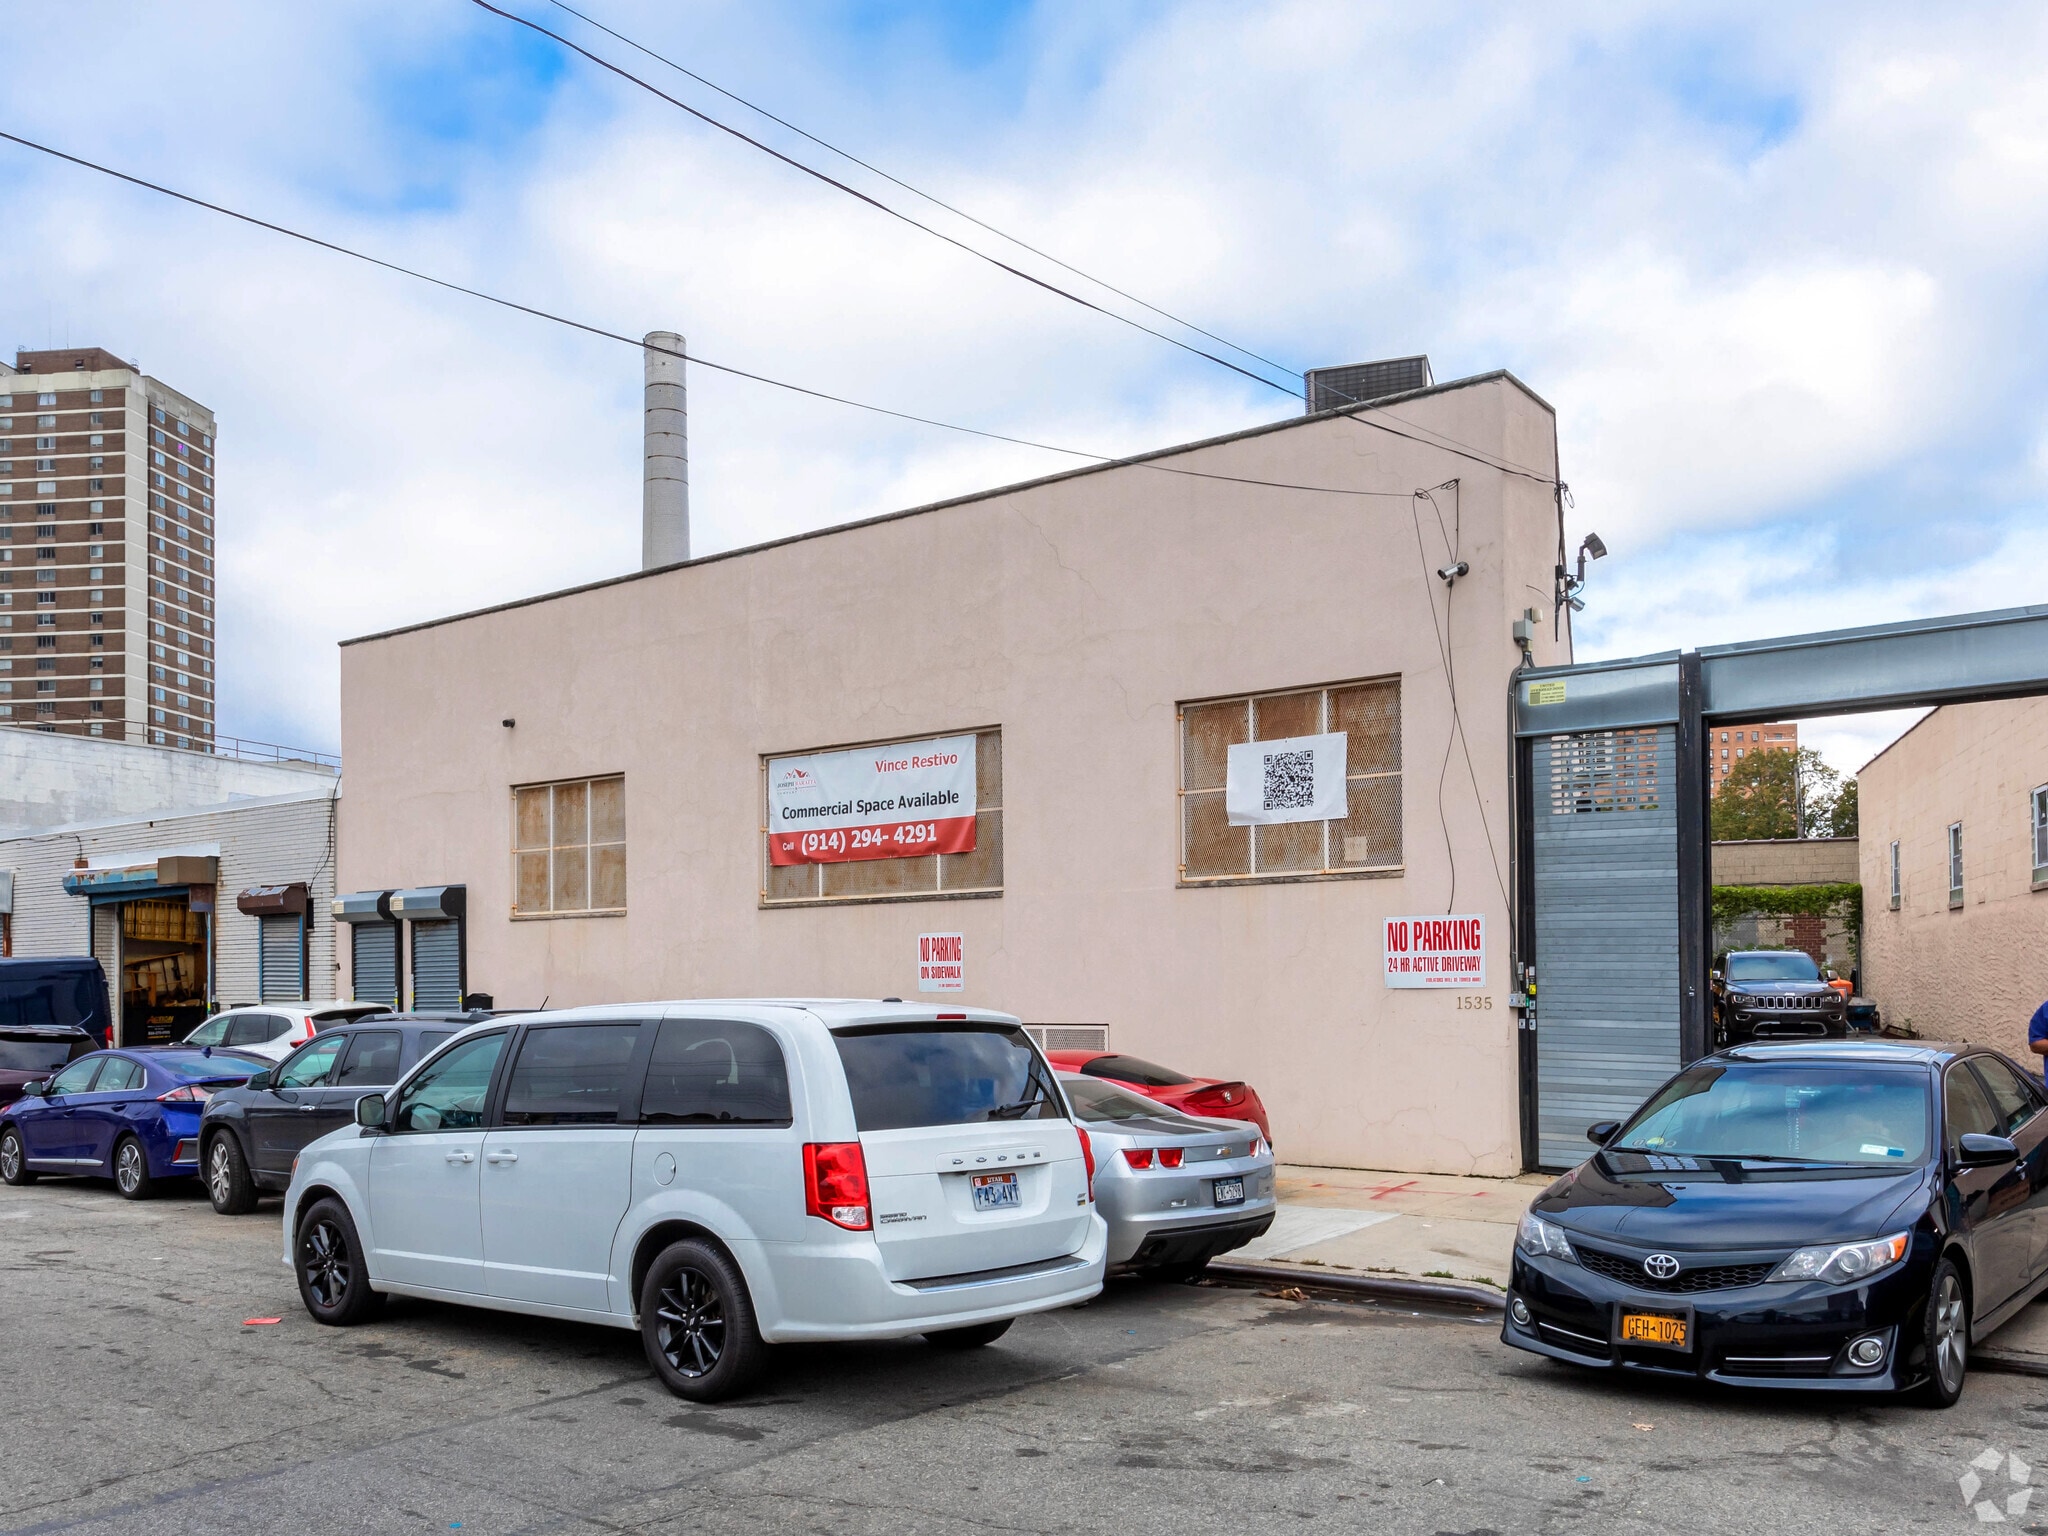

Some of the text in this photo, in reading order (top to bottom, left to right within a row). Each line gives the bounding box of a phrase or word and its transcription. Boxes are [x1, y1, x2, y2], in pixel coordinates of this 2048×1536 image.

[875, 752, 958, 773] Vince Restivo
[782, 790, 959, 820] Commercial Space Available
[782, 842, 794, 851] Call
[801, 831, 846, 855] (914)
[894, 823, 937, 844] 4291
[1388, 919, 1480, 952] NO PARKING
[920, 936, 961, 962] NO PARKING
[921, 966, 961, 979] ON SIDEWALK
[1388, 956, 1481, 972] 24 HR ACTIVE DRIVEWAY
[1457, 996, 1492, 1010] 1535
[952, 1152, 1041, 1165] DODGE
[987, 1176, 1003, 1184] UTAH
[1628, 1318, 1687, 1341] GEH 1025
